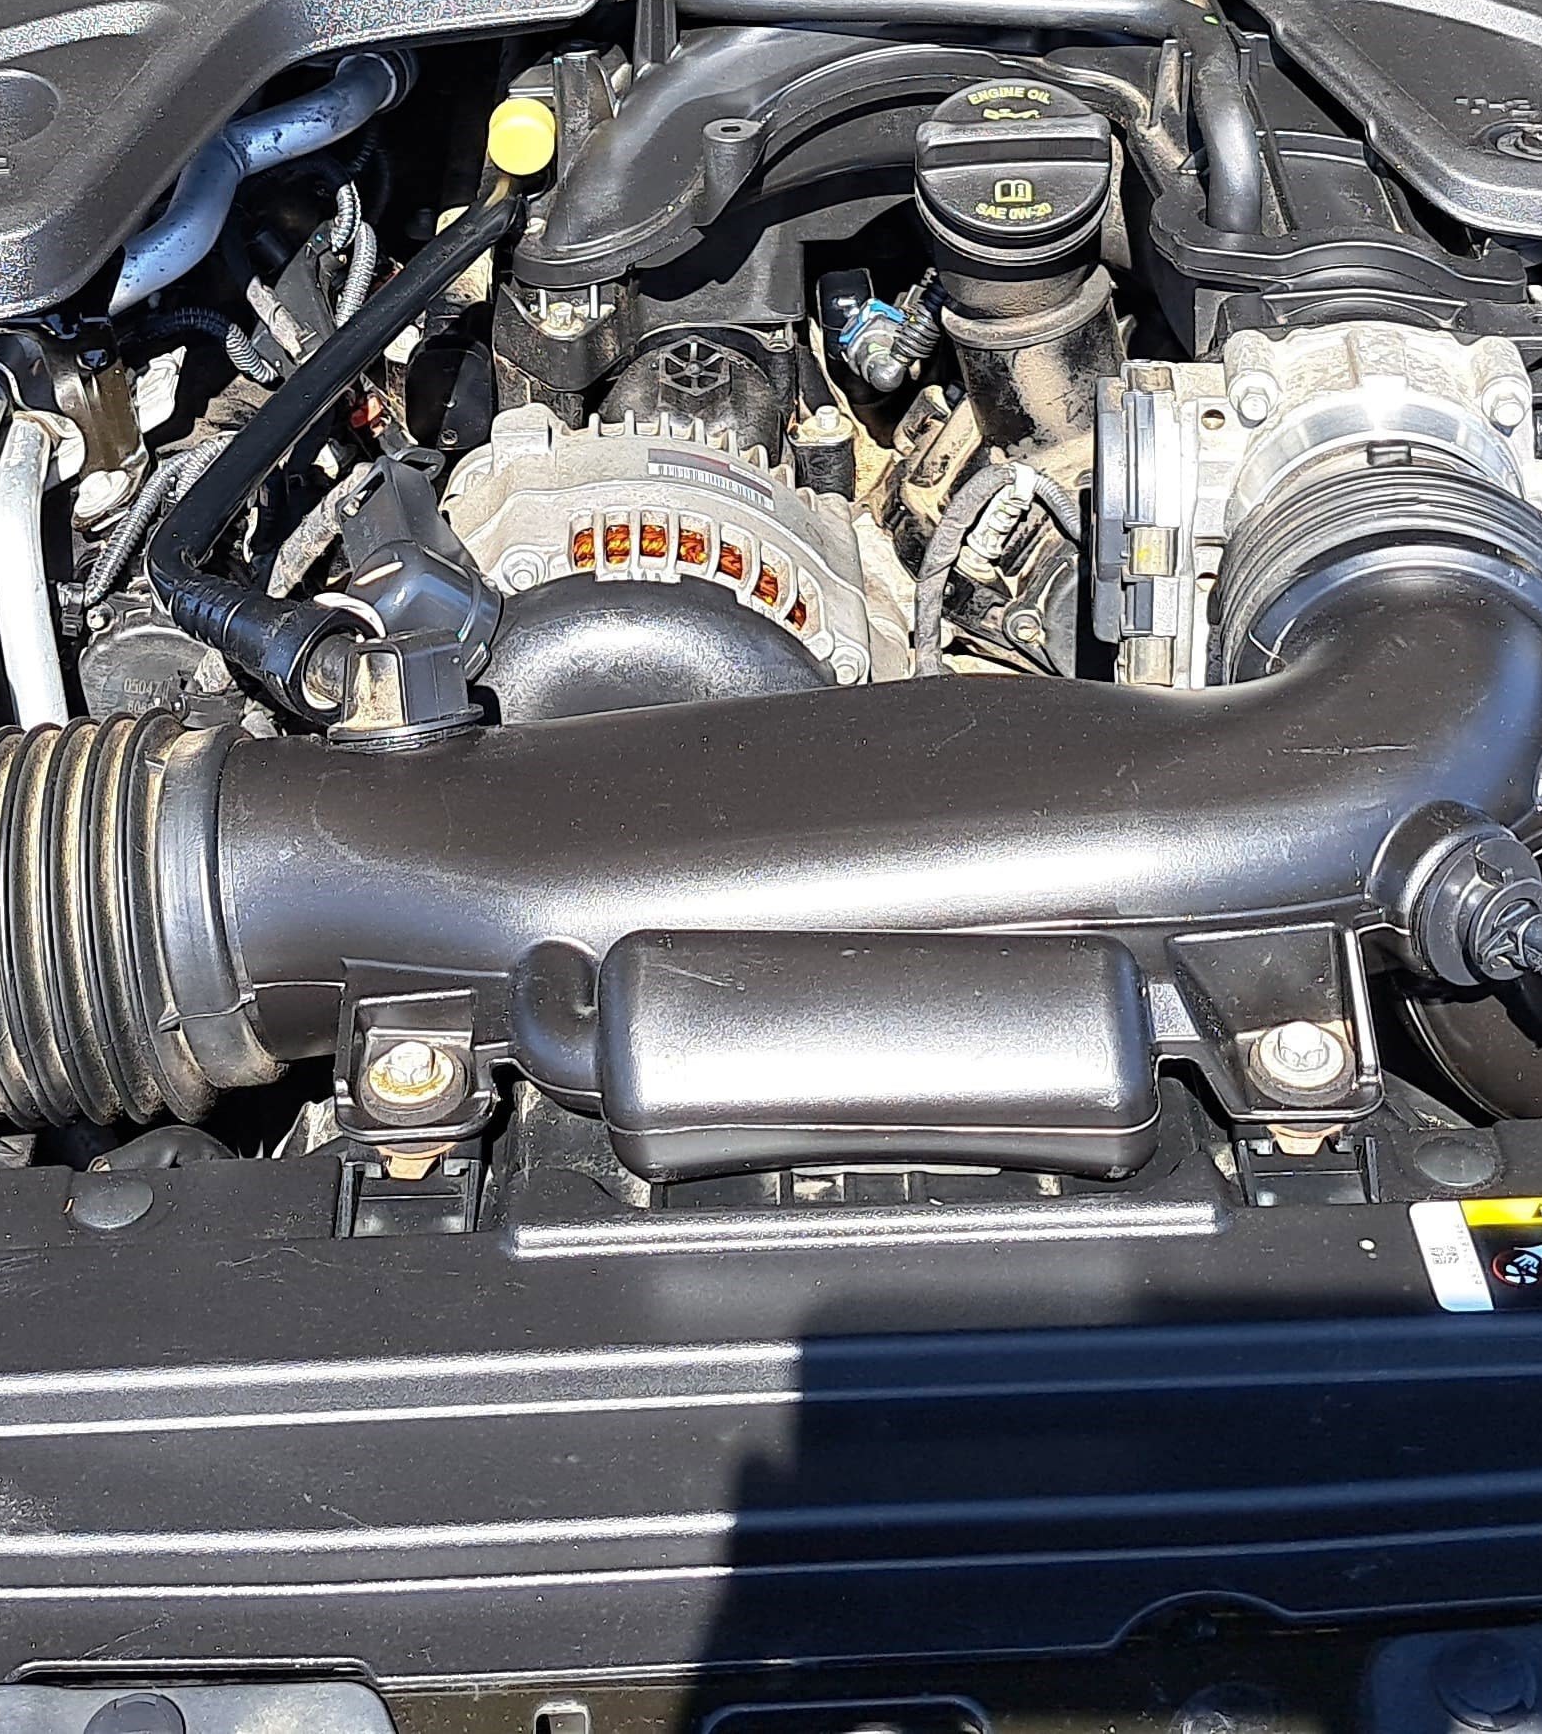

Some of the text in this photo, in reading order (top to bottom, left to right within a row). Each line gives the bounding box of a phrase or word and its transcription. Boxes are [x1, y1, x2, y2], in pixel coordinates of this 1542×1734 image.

[967, 86, 1052, 106] ENGINE OIL
[975, 202, 1008, 220] SAE
